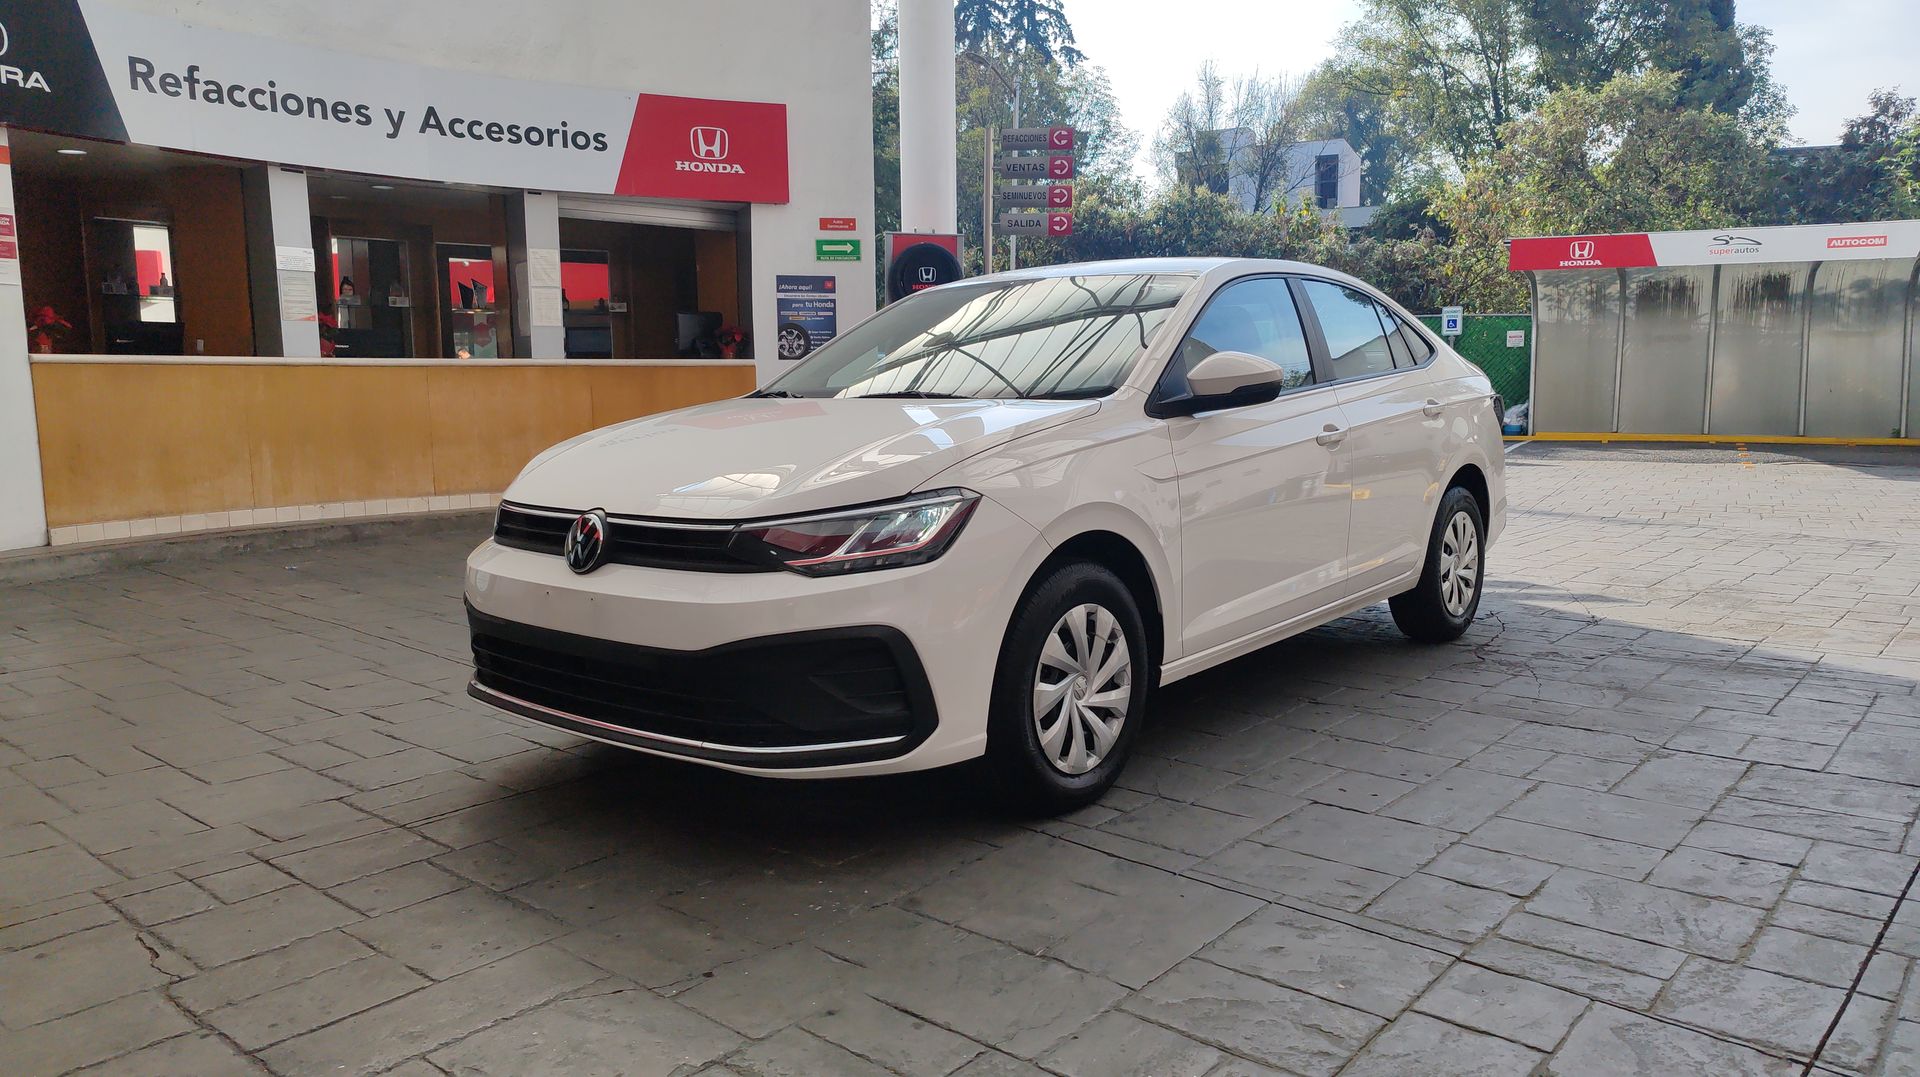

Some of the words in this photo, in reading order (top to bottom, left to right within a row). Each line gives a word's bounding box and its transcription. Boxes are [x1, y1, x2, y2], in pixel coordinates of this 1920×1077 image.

[127, 55, 372, 126] Refacciones
[384, 107, 406, 139] y
[418, 105, 608, 152] Accesorios
[1002, 134, 1047, 143] REFACCIONES
[674, 160, 745, 175] HONDA
[1006, 163, 1046, 172] VENTAS
[1002, 191, 1047, 200] SEMINUEVOS
[1007, 219, 1042, 228] SALIDA
[1829, 237, 1885, 247] AUTOCOM
[1709, 247, 1760, 255] superautos
